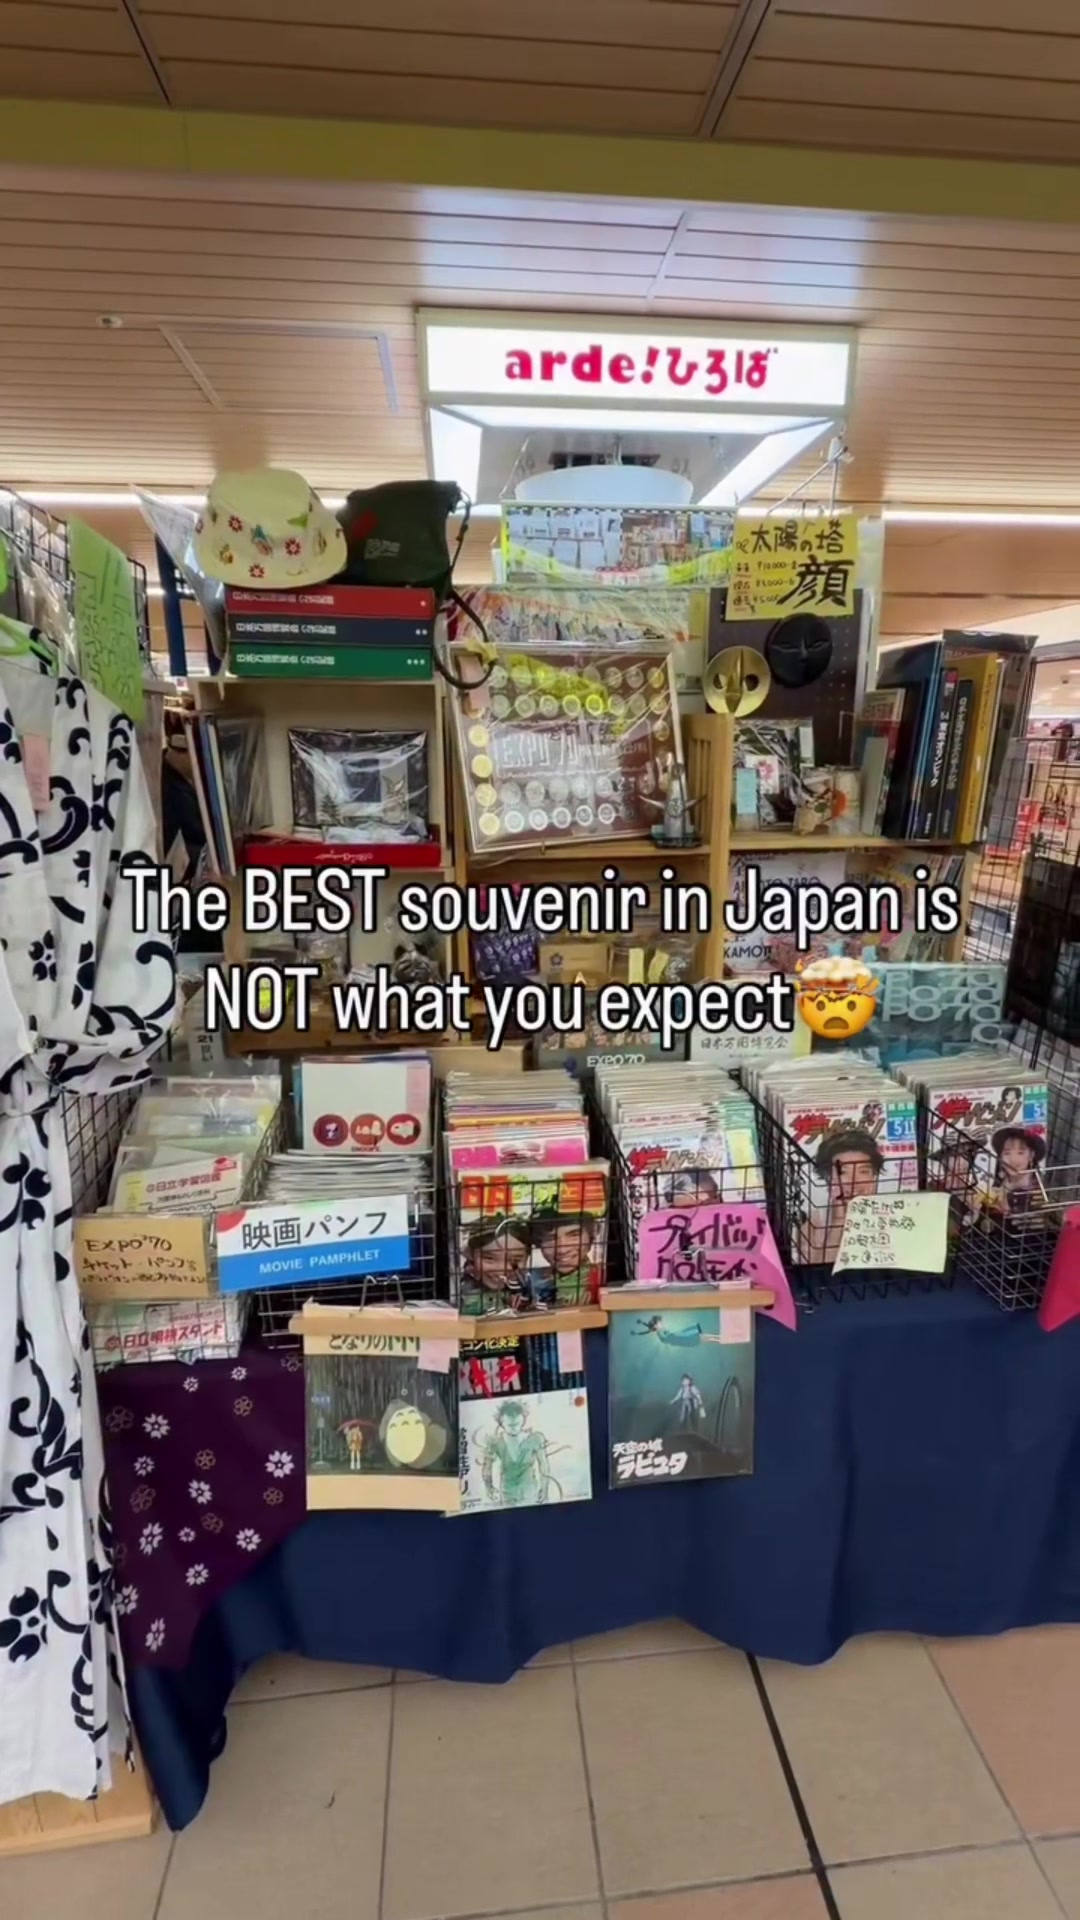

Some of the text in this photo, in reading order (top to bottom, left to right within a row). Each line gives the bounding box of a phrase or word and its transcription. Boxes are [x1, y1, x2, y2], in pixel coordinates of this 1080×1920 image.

[750, 518, 845, 554] 太陽の塔
[776, 554, 855, 609] 顔
[241, 1211, 388, 1251] 映画パンフ
[259, 1249, 381, 1275] MOVIE PAMPHLET
[617, 1451, 689, 1480] ラピュタ
